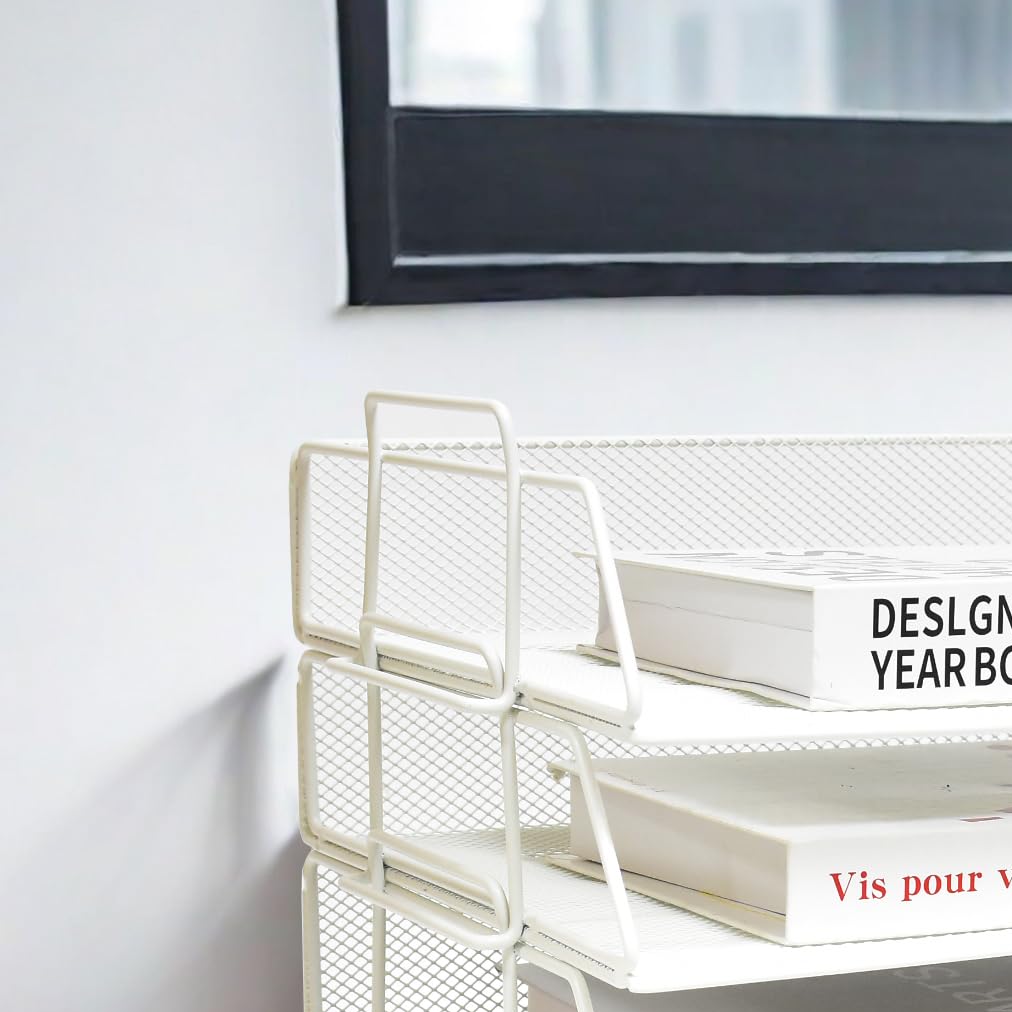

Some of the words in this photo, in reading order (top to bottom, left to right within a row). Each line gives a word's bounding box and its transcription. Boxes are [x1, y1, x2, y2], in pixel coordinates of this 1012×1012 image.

[870, 647, 967, 691] YEAR
[829, 870, 887, 902] Vis
[902, 871, 983, 902] pour
